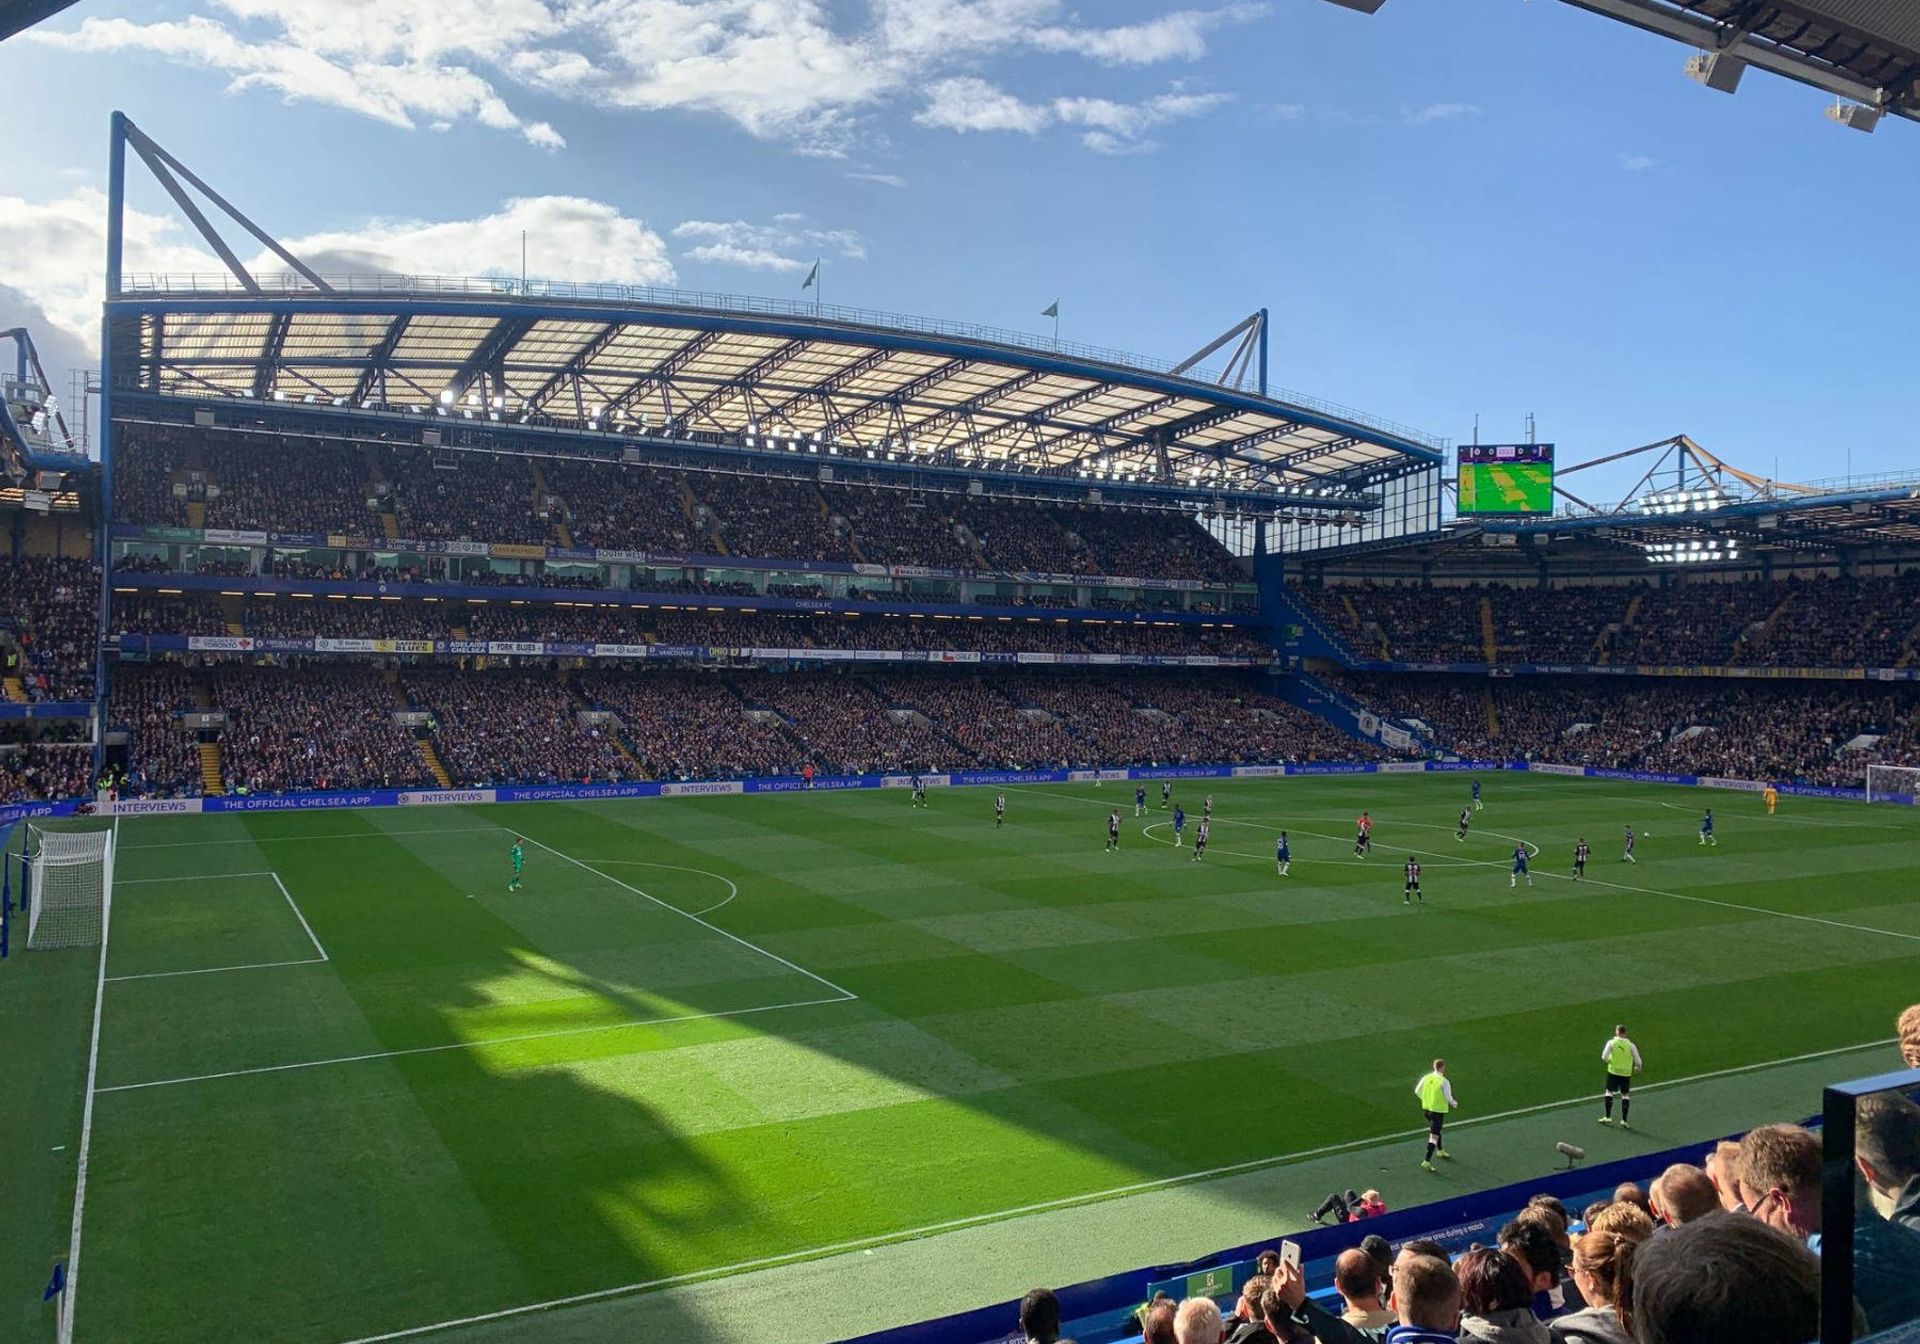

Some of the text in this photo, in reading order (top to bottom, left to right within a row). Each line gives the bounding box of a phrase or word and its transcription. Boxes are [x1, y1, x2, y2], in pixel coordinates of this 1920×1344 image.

[709, 647, 728, 656] OHIO
[681, 784, 732, 793] INTERVIEWS
[758, 780, 862, 791] THE OFFICIA CHELSEA APP
[1714, 780, 1757, 790] INTERVIEWS
[421, 792, 482, 802] INTERVIEWS
[514, 788, 638, 800] THE OFFICIAL CHELSEA APP
[1782, 786, 1795, 794] THE
[1798, 787, 1832, 797] OFFICIAL
[1835, 790, 1869, 800] CHELSE
[113, 802, 187, 814] INTERVIEWS
[224, 796, 371, 810] THE OFFICIAL CHELSEA APP
[30, 808, 52, 816] APP
[1446, 1228, 1464, 1238] during
[1468, 1222, 1485, 1232] match
